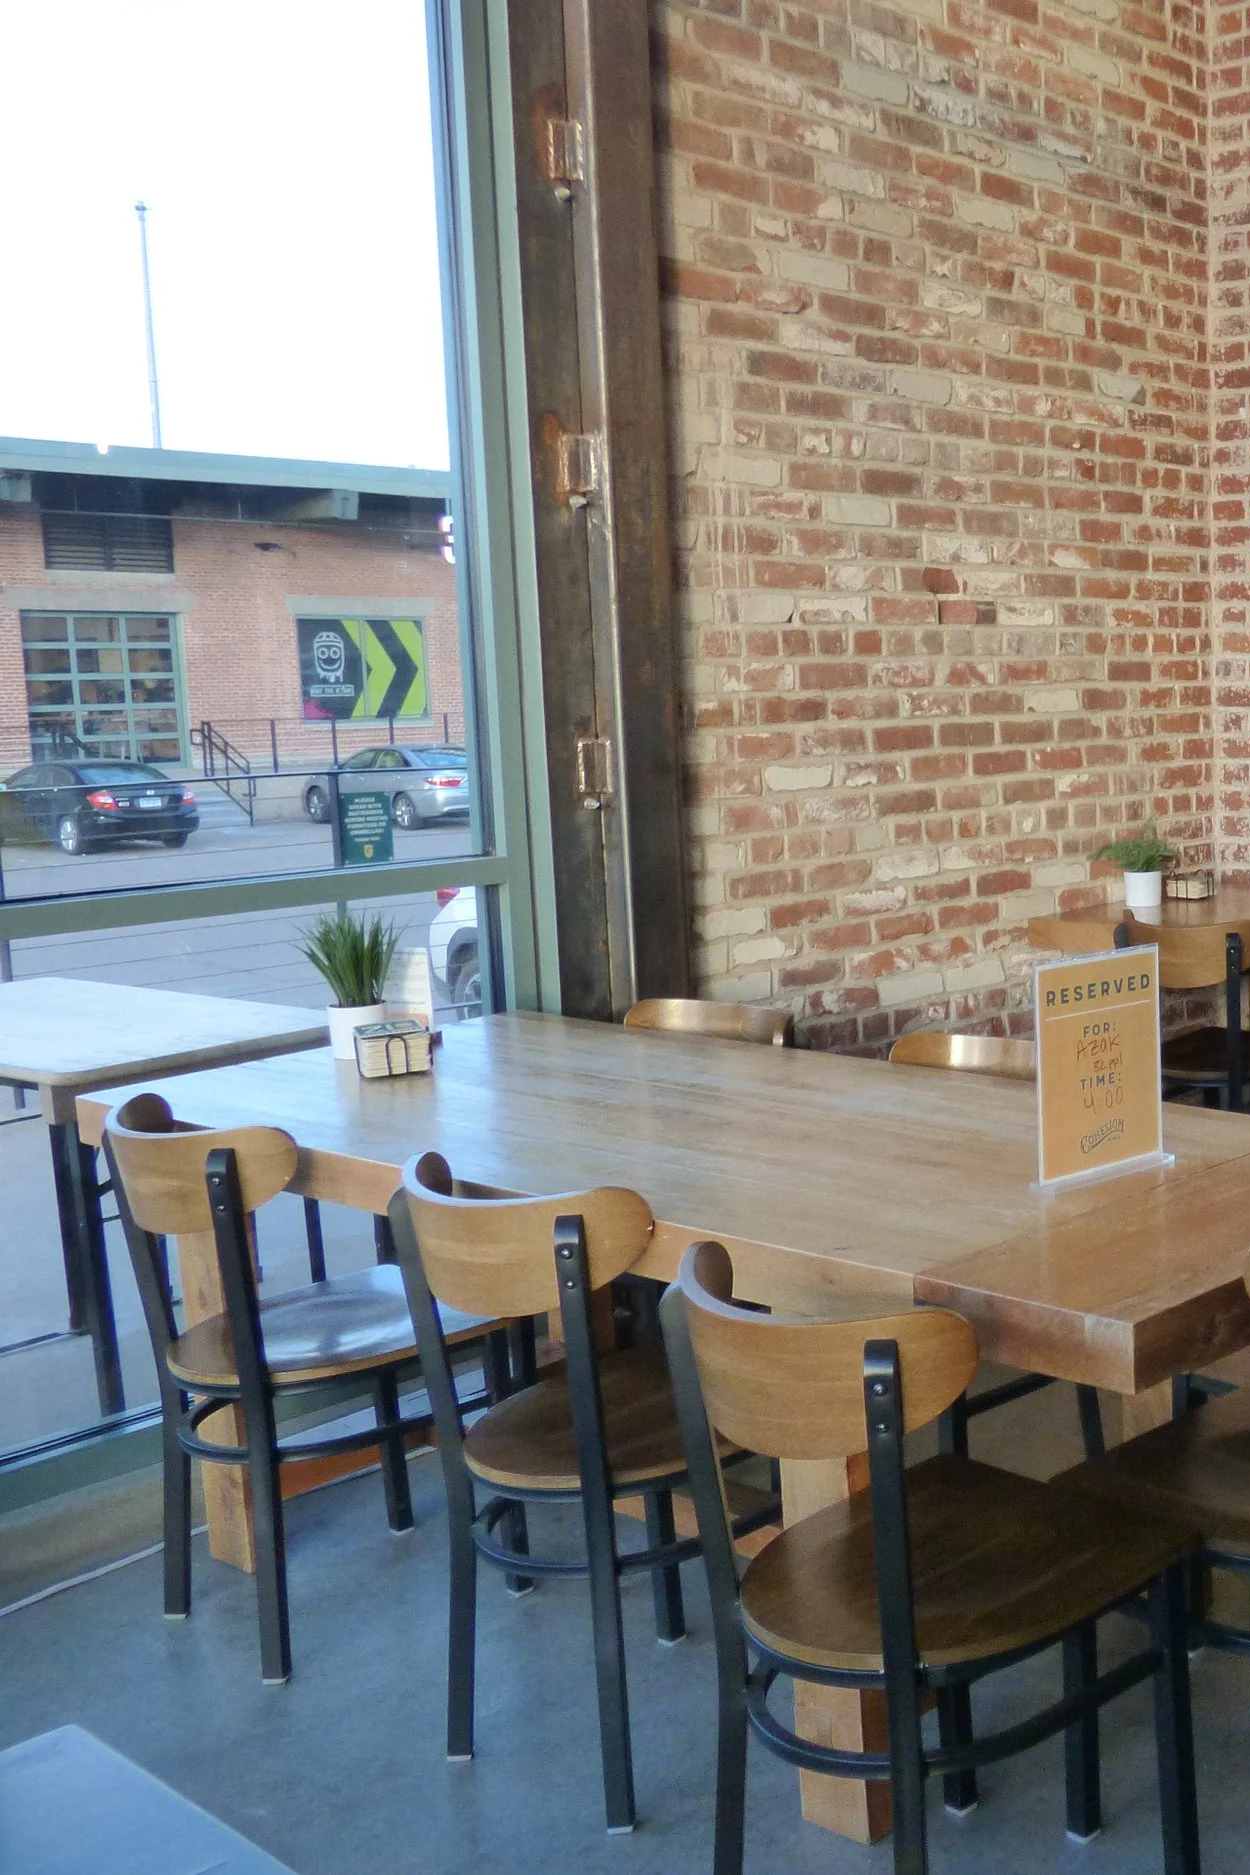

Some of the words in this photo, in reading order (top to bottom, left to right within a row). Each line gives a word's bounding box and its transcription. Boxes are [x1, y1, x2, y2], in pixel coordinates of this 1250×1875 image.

[1046, 973, 1150, 1007] RESERVED
[1083, 1021, 1117, 1038] FOR:
[1080, 1071, 1122, 1091] TIME:
[1080, 1118, 1125, 1155] COHESION
